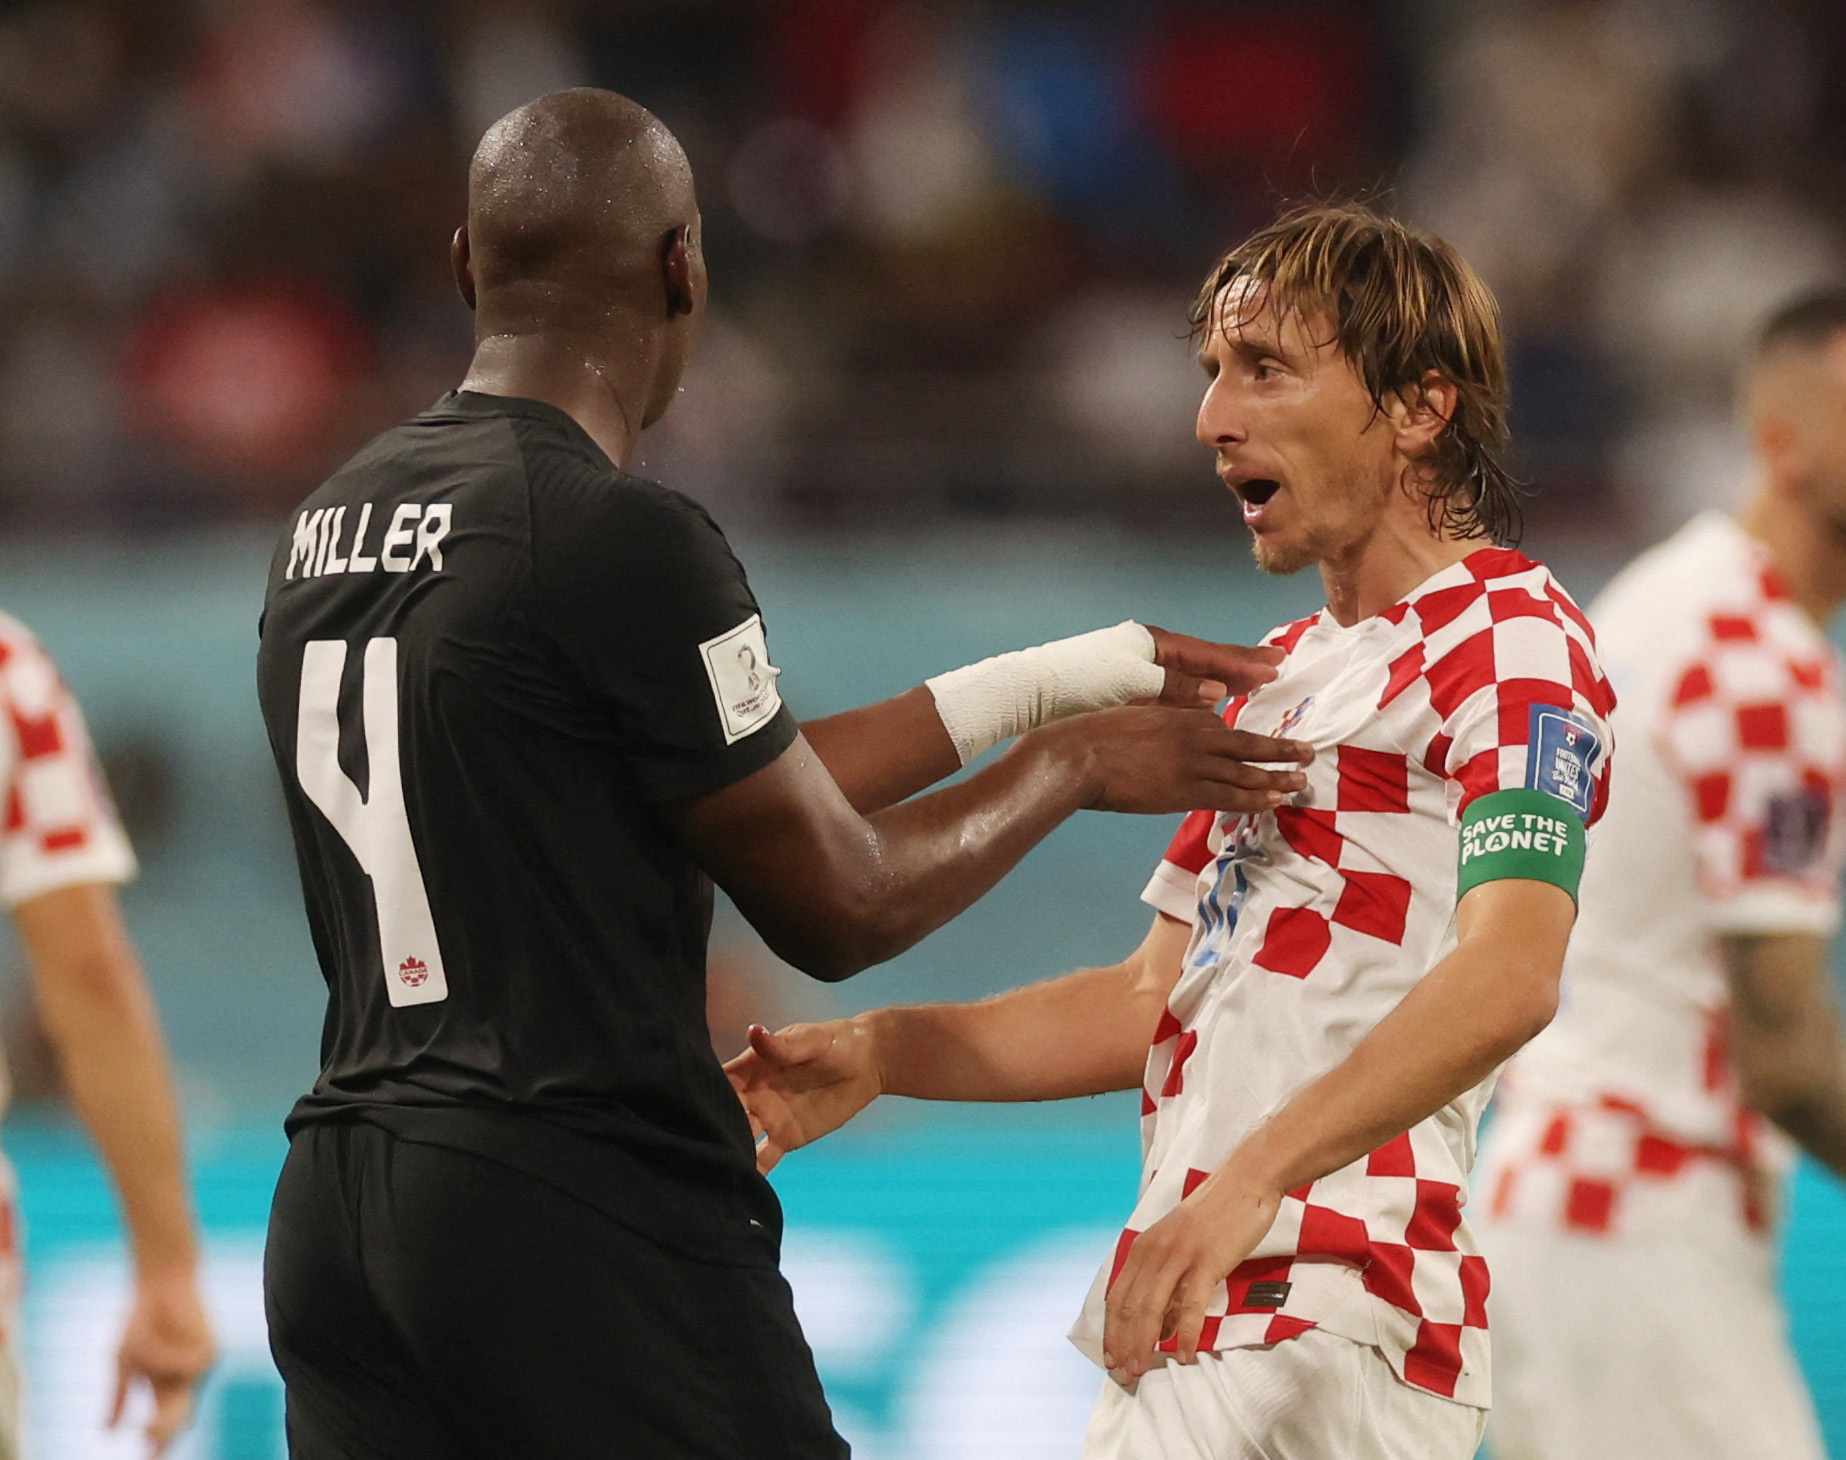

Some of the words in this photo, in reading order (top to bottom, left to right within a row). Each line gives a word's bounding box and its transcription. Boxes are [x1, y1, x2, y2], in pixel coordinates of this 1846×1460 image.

[286, 503, 452, 580] MILLER
[297, 637, 449, 1007] 4
[1463, 814, 1516, 843] SAVE
[1521, 814, 1567, 838] THE
